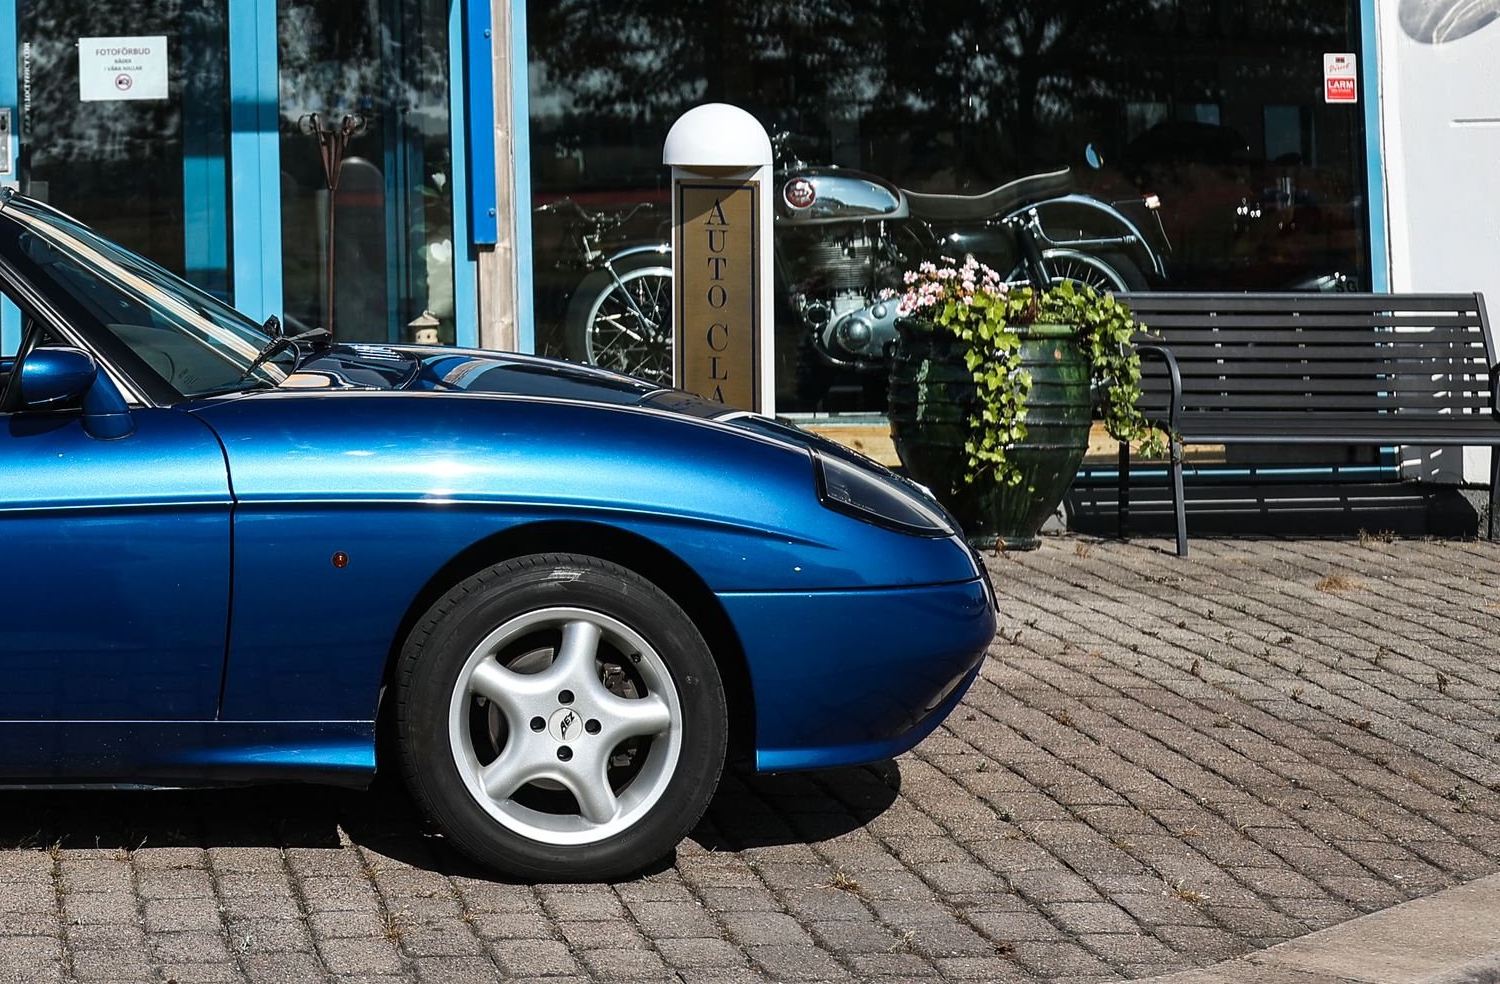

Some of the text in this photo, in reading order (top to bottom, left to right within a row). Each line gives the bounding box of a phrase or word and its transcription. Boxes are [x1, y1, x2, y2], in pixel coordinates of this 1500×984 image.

[95, 47, 151, 56] FOTOFÖRBUD
[1328, 80, 1353, 89] LARM
[704, 199, 730, 309] AUTO
